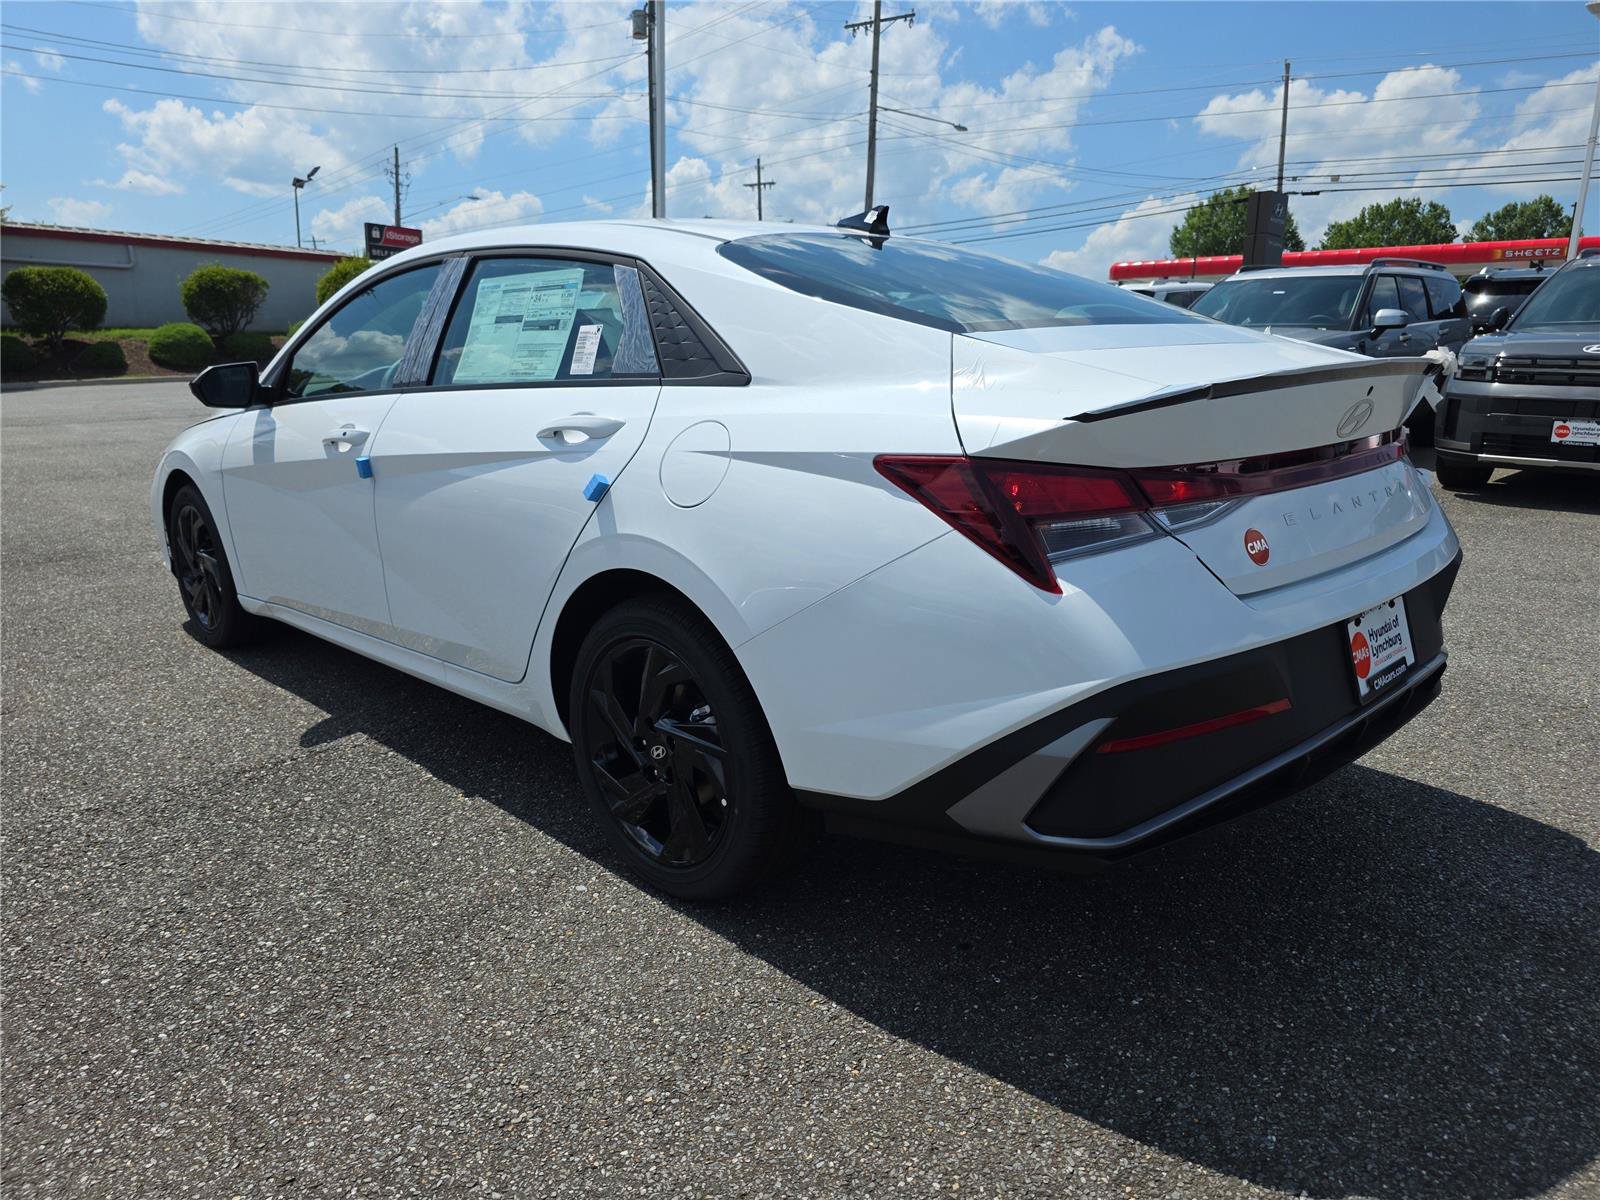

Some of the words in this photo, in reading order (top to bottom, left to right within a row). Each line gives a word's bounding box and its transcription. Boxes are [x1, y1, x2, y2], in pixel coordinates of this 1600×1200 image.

[386, 231, 419, 243] iStorage
[1505, 248, 1560, 257] SHEETZ
[1283, 481, 1405, 526] ELANTRA
[1247, 538, 1269, 555] CMA
[1367, 619, 1393, 642] Hyundai
[1393, 614, 1400, 628] of
[1370, 632, 1403, 658] Lynchburg
[1373, 664, 1408, 690] CMAcars.com
